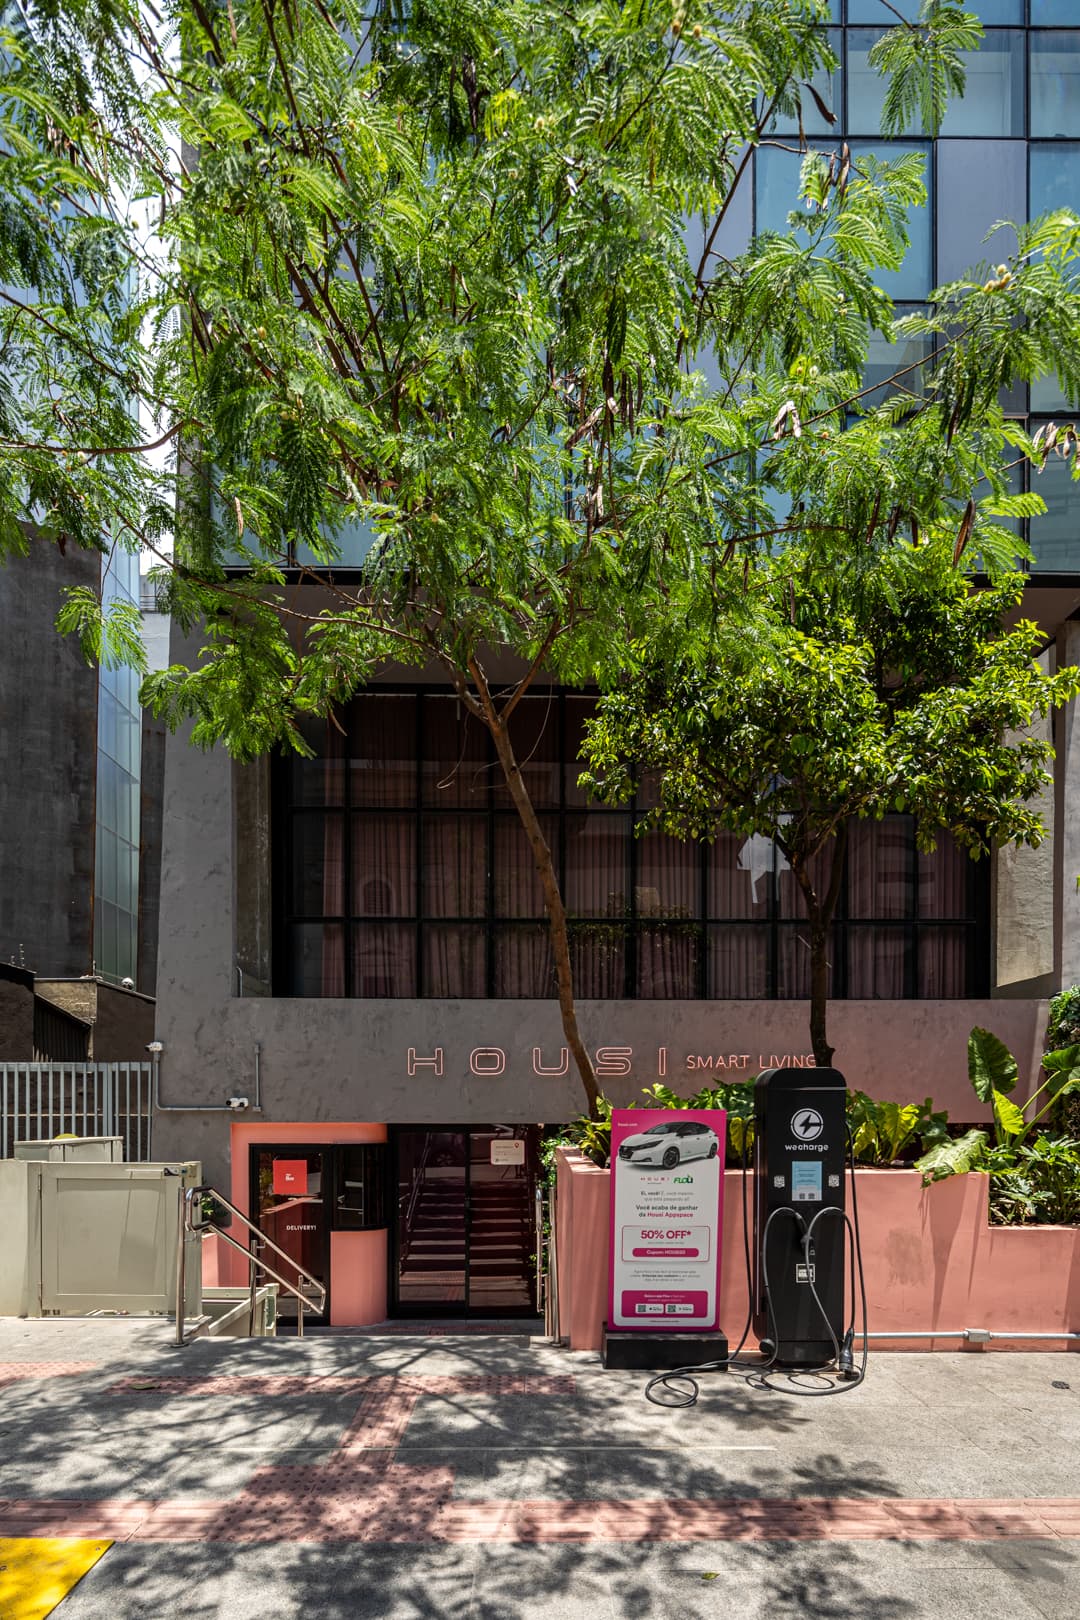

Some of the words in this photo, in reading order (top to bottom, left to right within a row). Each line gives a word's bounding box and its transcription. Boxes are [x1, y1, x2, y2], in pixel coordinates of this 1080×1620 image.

[408, 1047, 666, 1076] HOUSI
[686, 1054, 750, 1070] SMART
[759, 1054, 817, 1070] LIVING
[784, 1143, 829, 1153] wecharge
[678, 1204, 698, 1212] ganhar
[665, 1211, 694, 1219] Appspace
[640, 1229, 664, 1240] 50%
